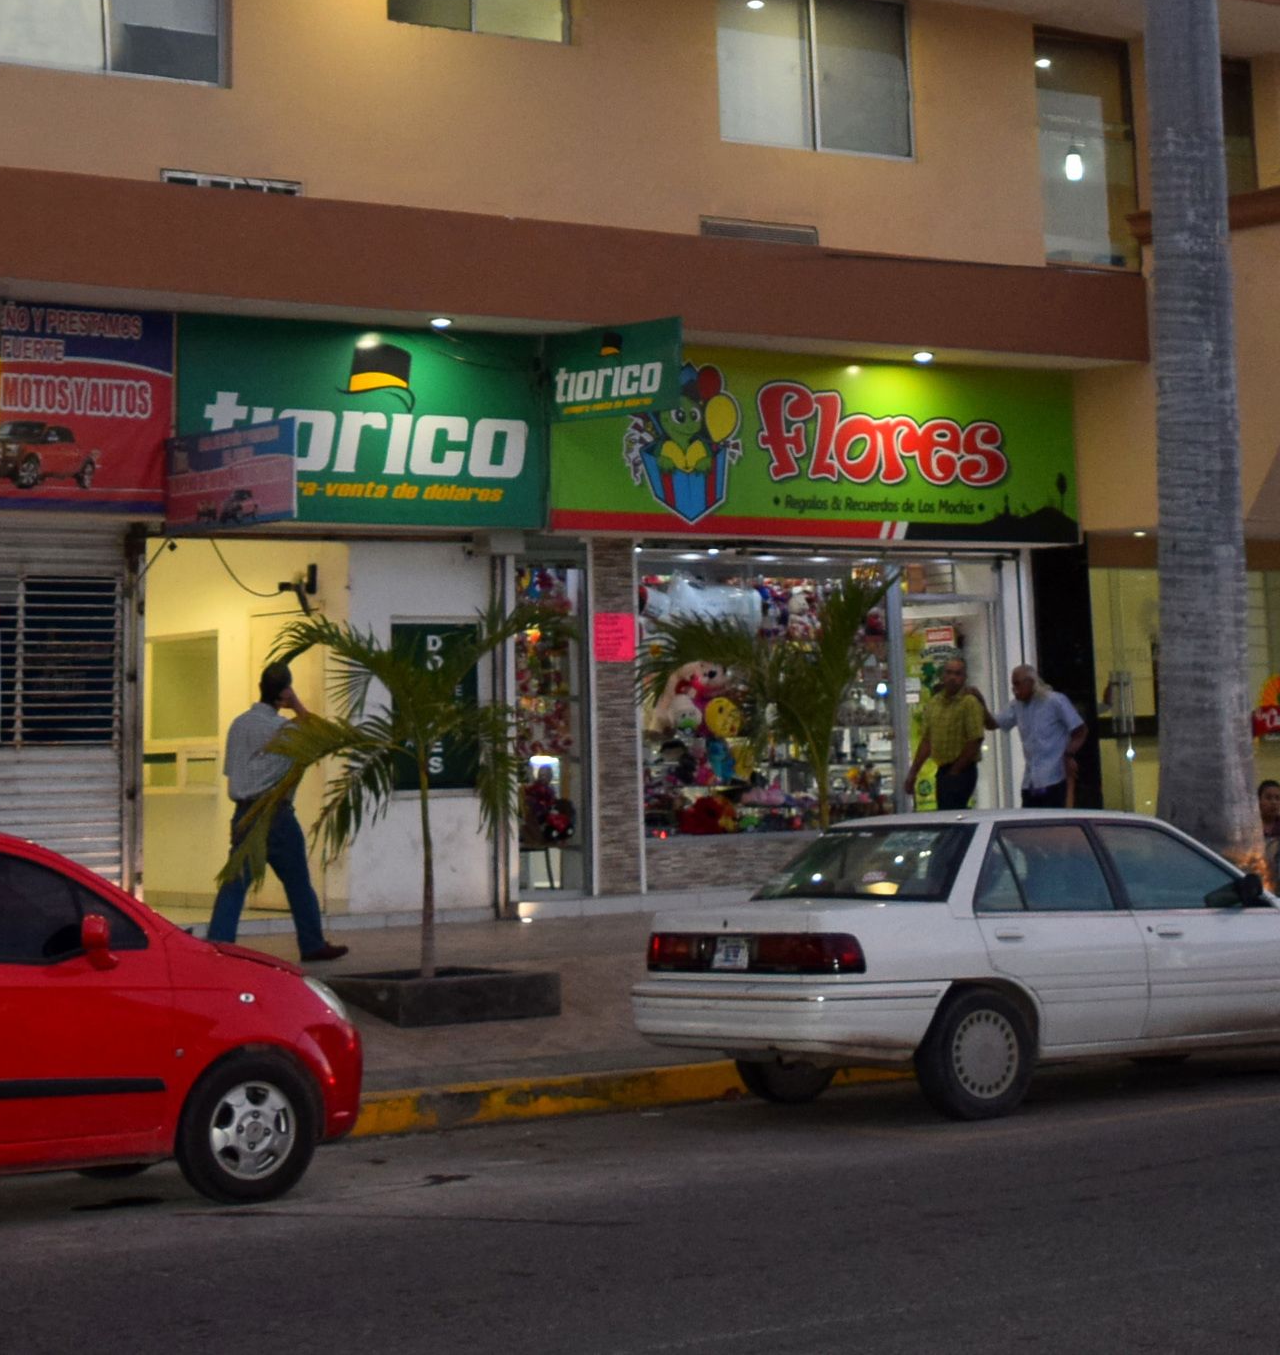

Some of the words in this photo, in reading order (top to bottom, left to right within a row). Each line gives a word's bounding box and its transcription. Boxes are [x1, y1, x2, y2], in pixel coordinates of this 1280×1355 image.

[32, 307, 45, 334] Y
[46, 308, 142, 340] PRESTAMOS
[0, 334, 65, 361] FUERTE
[0, 372, 72, 415] MOTOS
[85, 377, 152, 420] AUTOS
[555, 361, 663, 404] tiorico
[204, 390, 529, 479] torico
